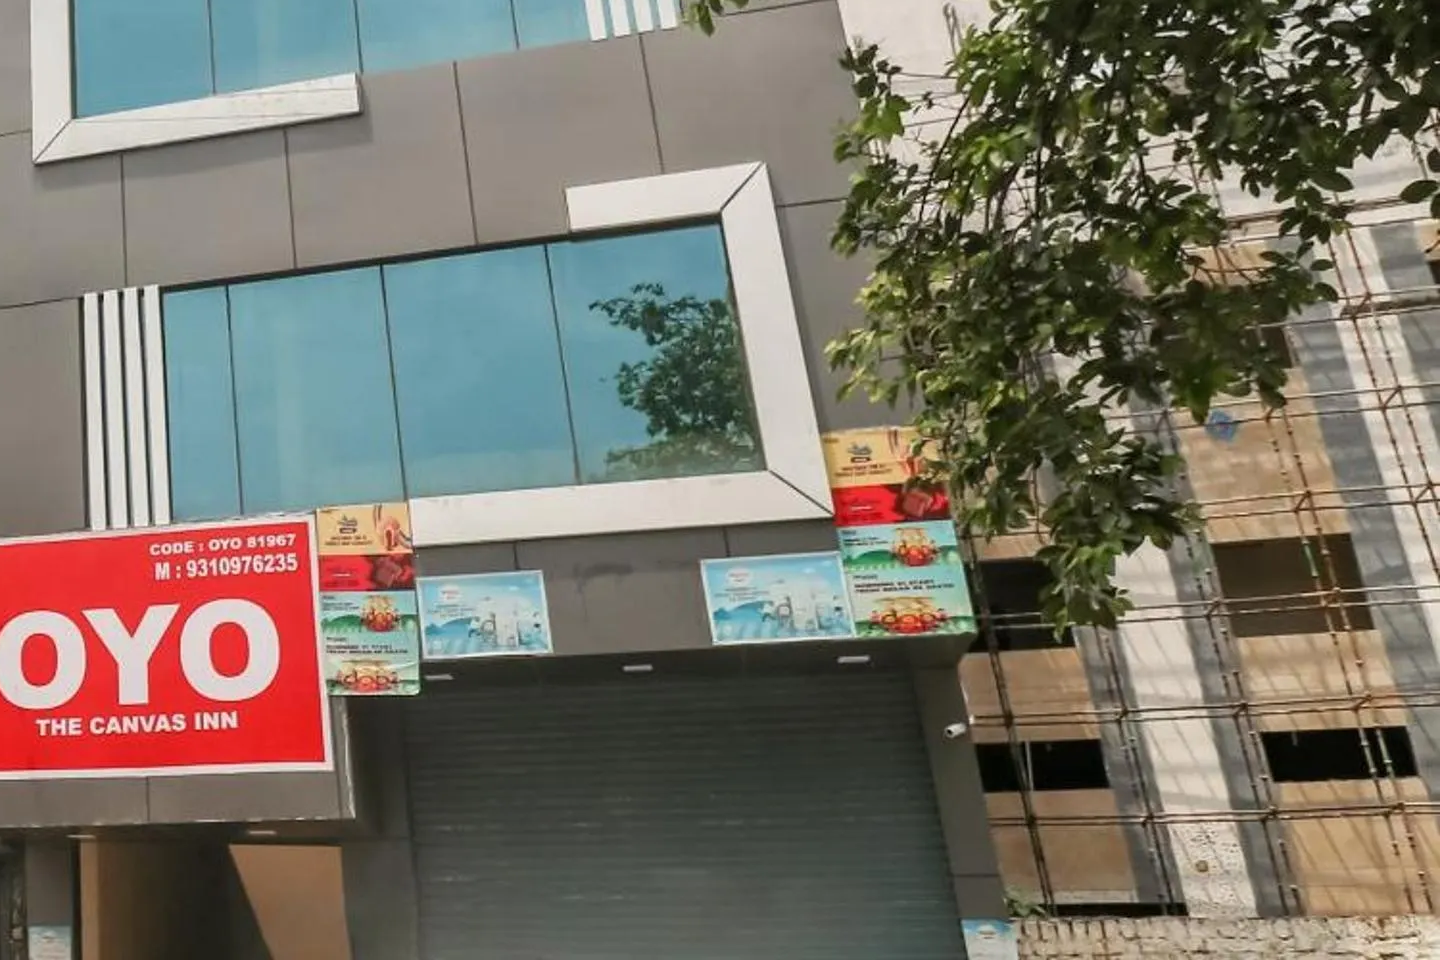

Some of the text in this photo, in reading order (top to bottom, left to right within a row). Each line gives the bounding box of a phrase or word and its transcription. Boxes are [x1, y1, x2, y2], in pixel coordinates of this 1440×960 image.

[149, 541, 194, 556] CODE
[208, 538, 242, 552] OYO
[154, 561, 171, 581] M
[186, 553, 298, 579] 9310976235
[35, 711, 239, 737] THE CANVAS INN
